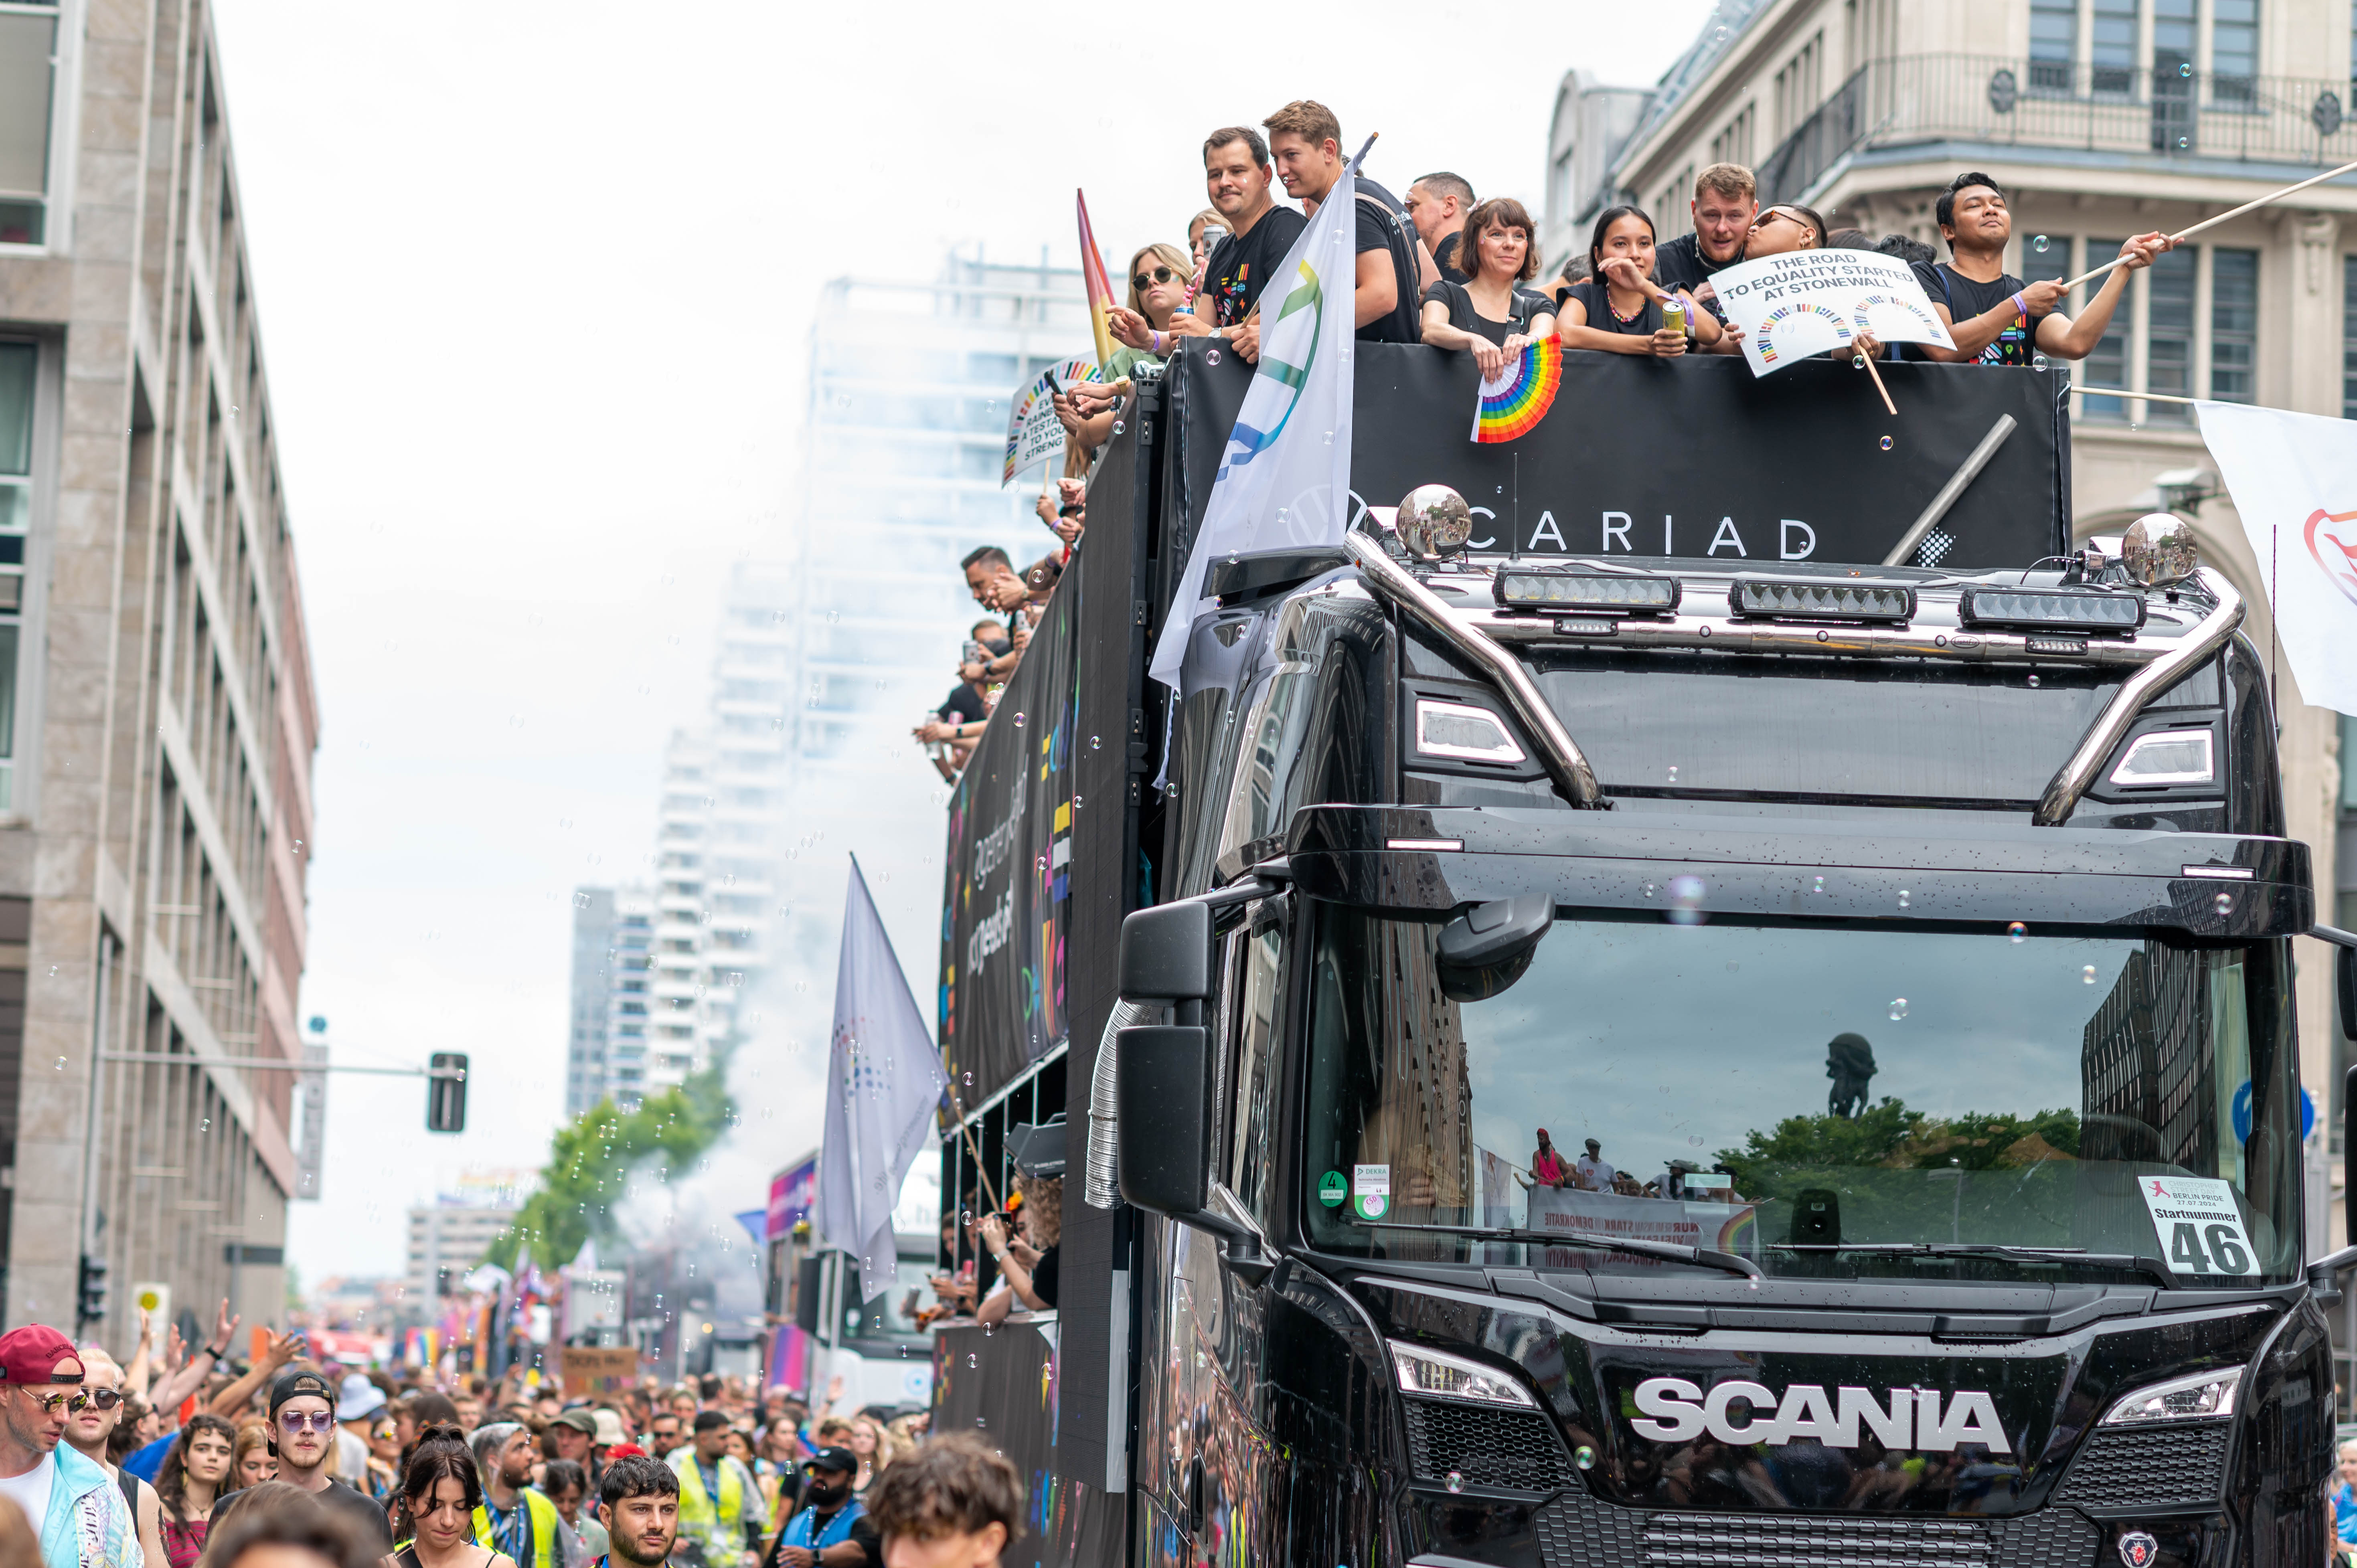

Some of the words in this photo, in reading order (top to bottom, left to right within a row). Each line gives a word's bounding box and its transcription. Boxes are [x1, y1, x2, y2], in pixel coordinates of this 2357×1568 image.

[1770, 257, 1807, 271] THE
[1808, 254, 1857, 265] ROAD
[1724, 284, 1749, 299] TO
[1753, 265, 1837, 291] EQUALITY
[1845, 265, 1914, 282] STARTED
[1765, 287, 1784, 301] AT
[1788, 277, 1893, 296] STONEWALL
[1027, 407, 1055, 428] RAINB
[1022, 432, 1027, 442] A
[1029, 417, 1061, 437] TESTA
[1031, 435, 1042, 447] TO
[1045, 424, 1065, 440] YOU
[1025, 436, 1065, 461] STRENG
[1467, 506, 1816, 560] CARIAD
[1327, 1172, 1336, 1189] 4
[2169, 1181, 2219, 1190] CHRISTOPHER
[1366, 1196, 1377, 1205] CSD
[2155, 1208, 2236, 1222] Startnummer
[2171, 1222, 2250, 1274] 46
[1631, 1377, 2012, 1454] SCANIA
